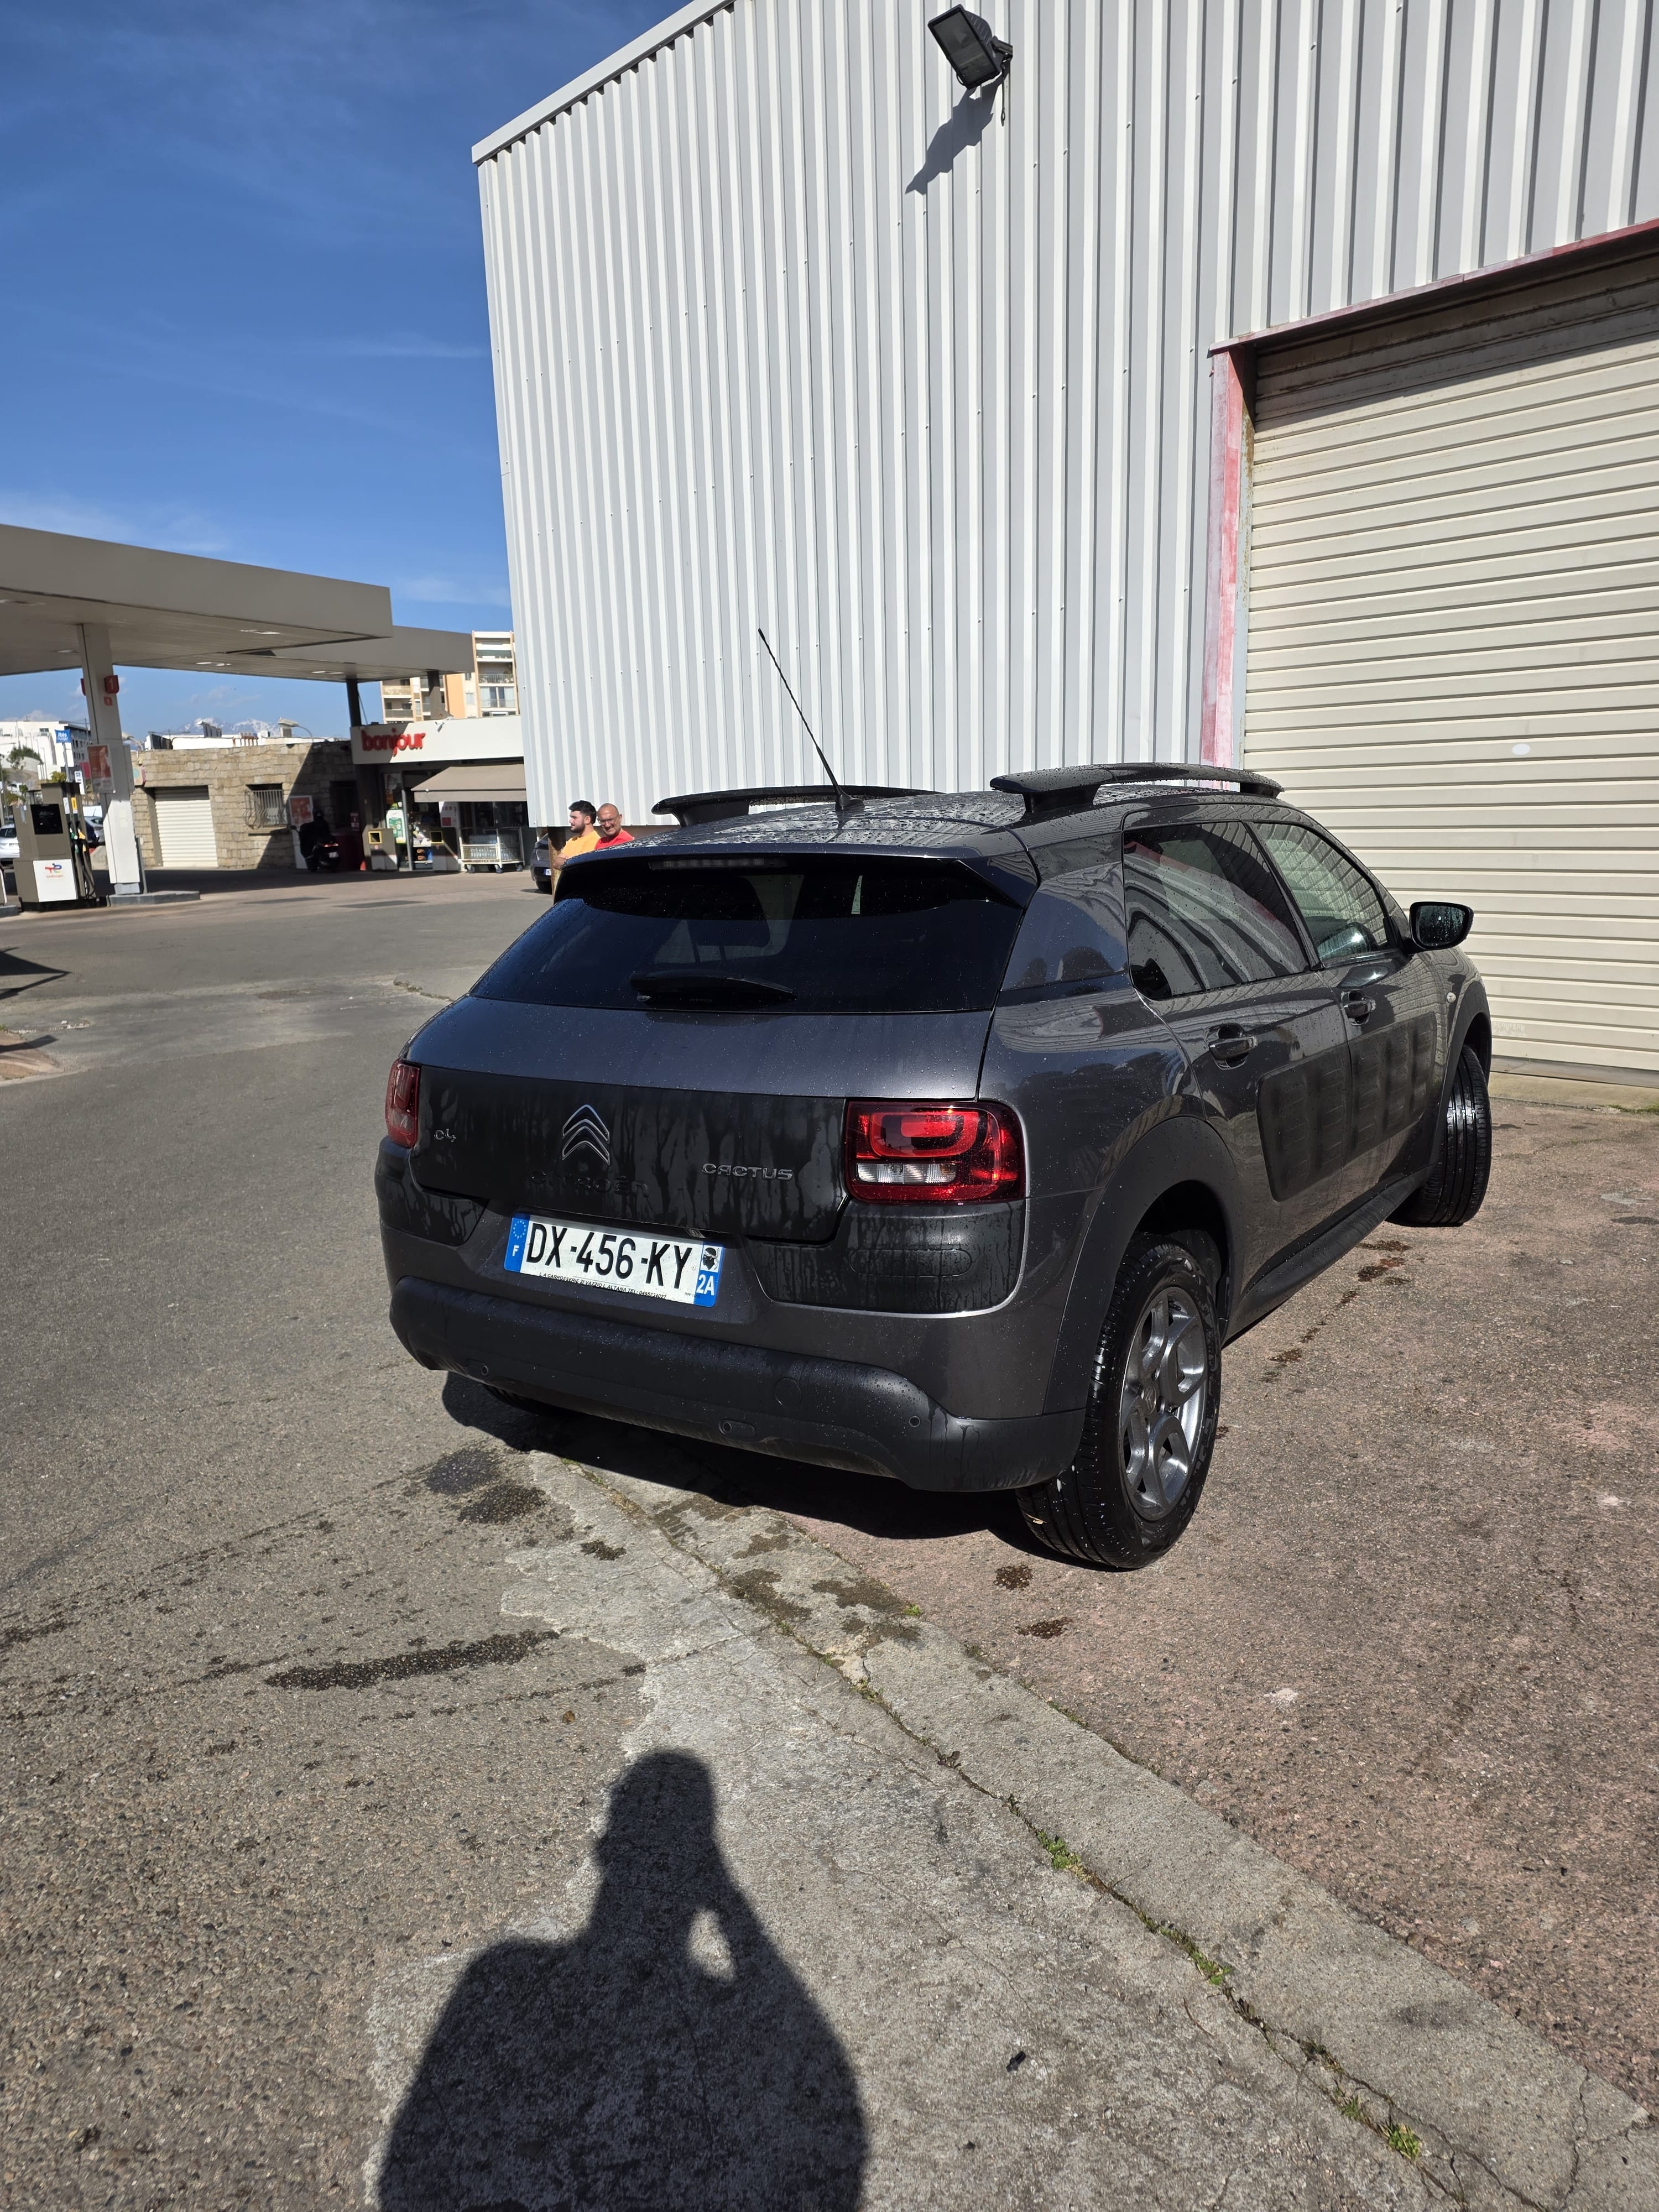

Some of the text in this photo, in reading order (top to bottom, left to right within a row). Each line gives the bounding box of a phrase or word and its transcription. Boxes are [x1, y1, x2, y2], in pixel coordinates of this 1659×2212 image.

[361, 727, 426, 757] bonjour
[434, 1128, 456, 1142] C4
[702, 1163, 792, 1180] CACTUS
[512, 1245, 519, 1256] F
[526, 1223, 692, 1289] DX-456-KY
[547, 1274, 580, 1284] CARROSSERIE
[696, 1274, 715, 1296] 2A
